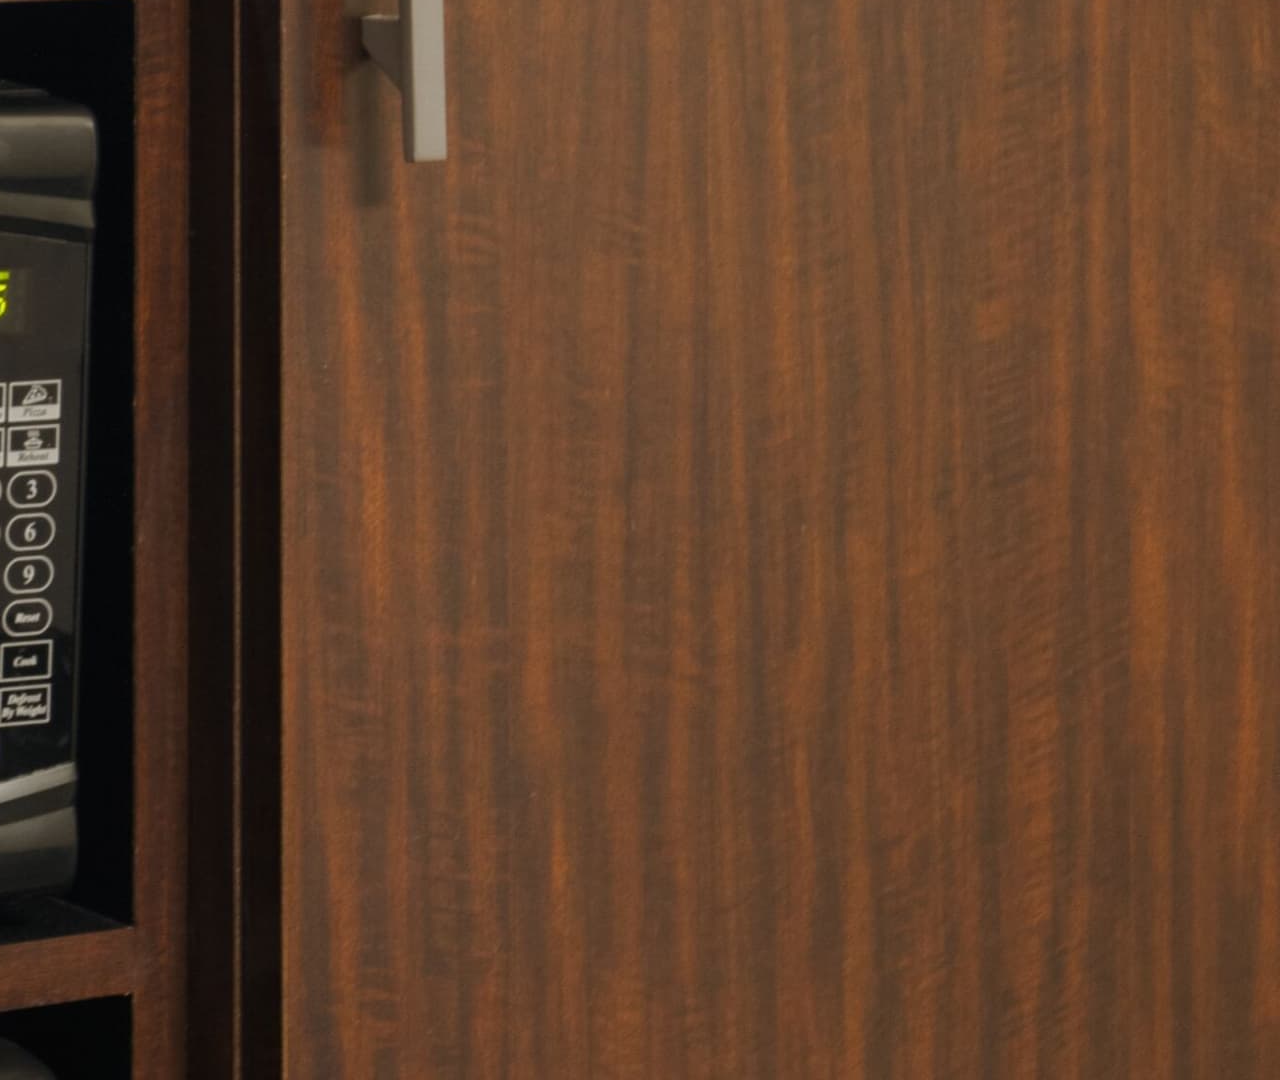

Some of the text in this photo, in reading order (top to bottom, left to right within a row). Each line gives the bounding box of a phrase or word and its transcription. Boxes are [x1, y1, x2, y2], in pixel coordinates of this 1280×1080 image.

[22, 407, 47, 417] Pizza
[17, 452, 49, 462] Reheat
[26, 479, 38, 499] 3
[24, 522, 37, 542] 6
[22, 565, 35, 585] 9
[13, 655, 38, 668] Cook
[1, 707, 15, 719] By
